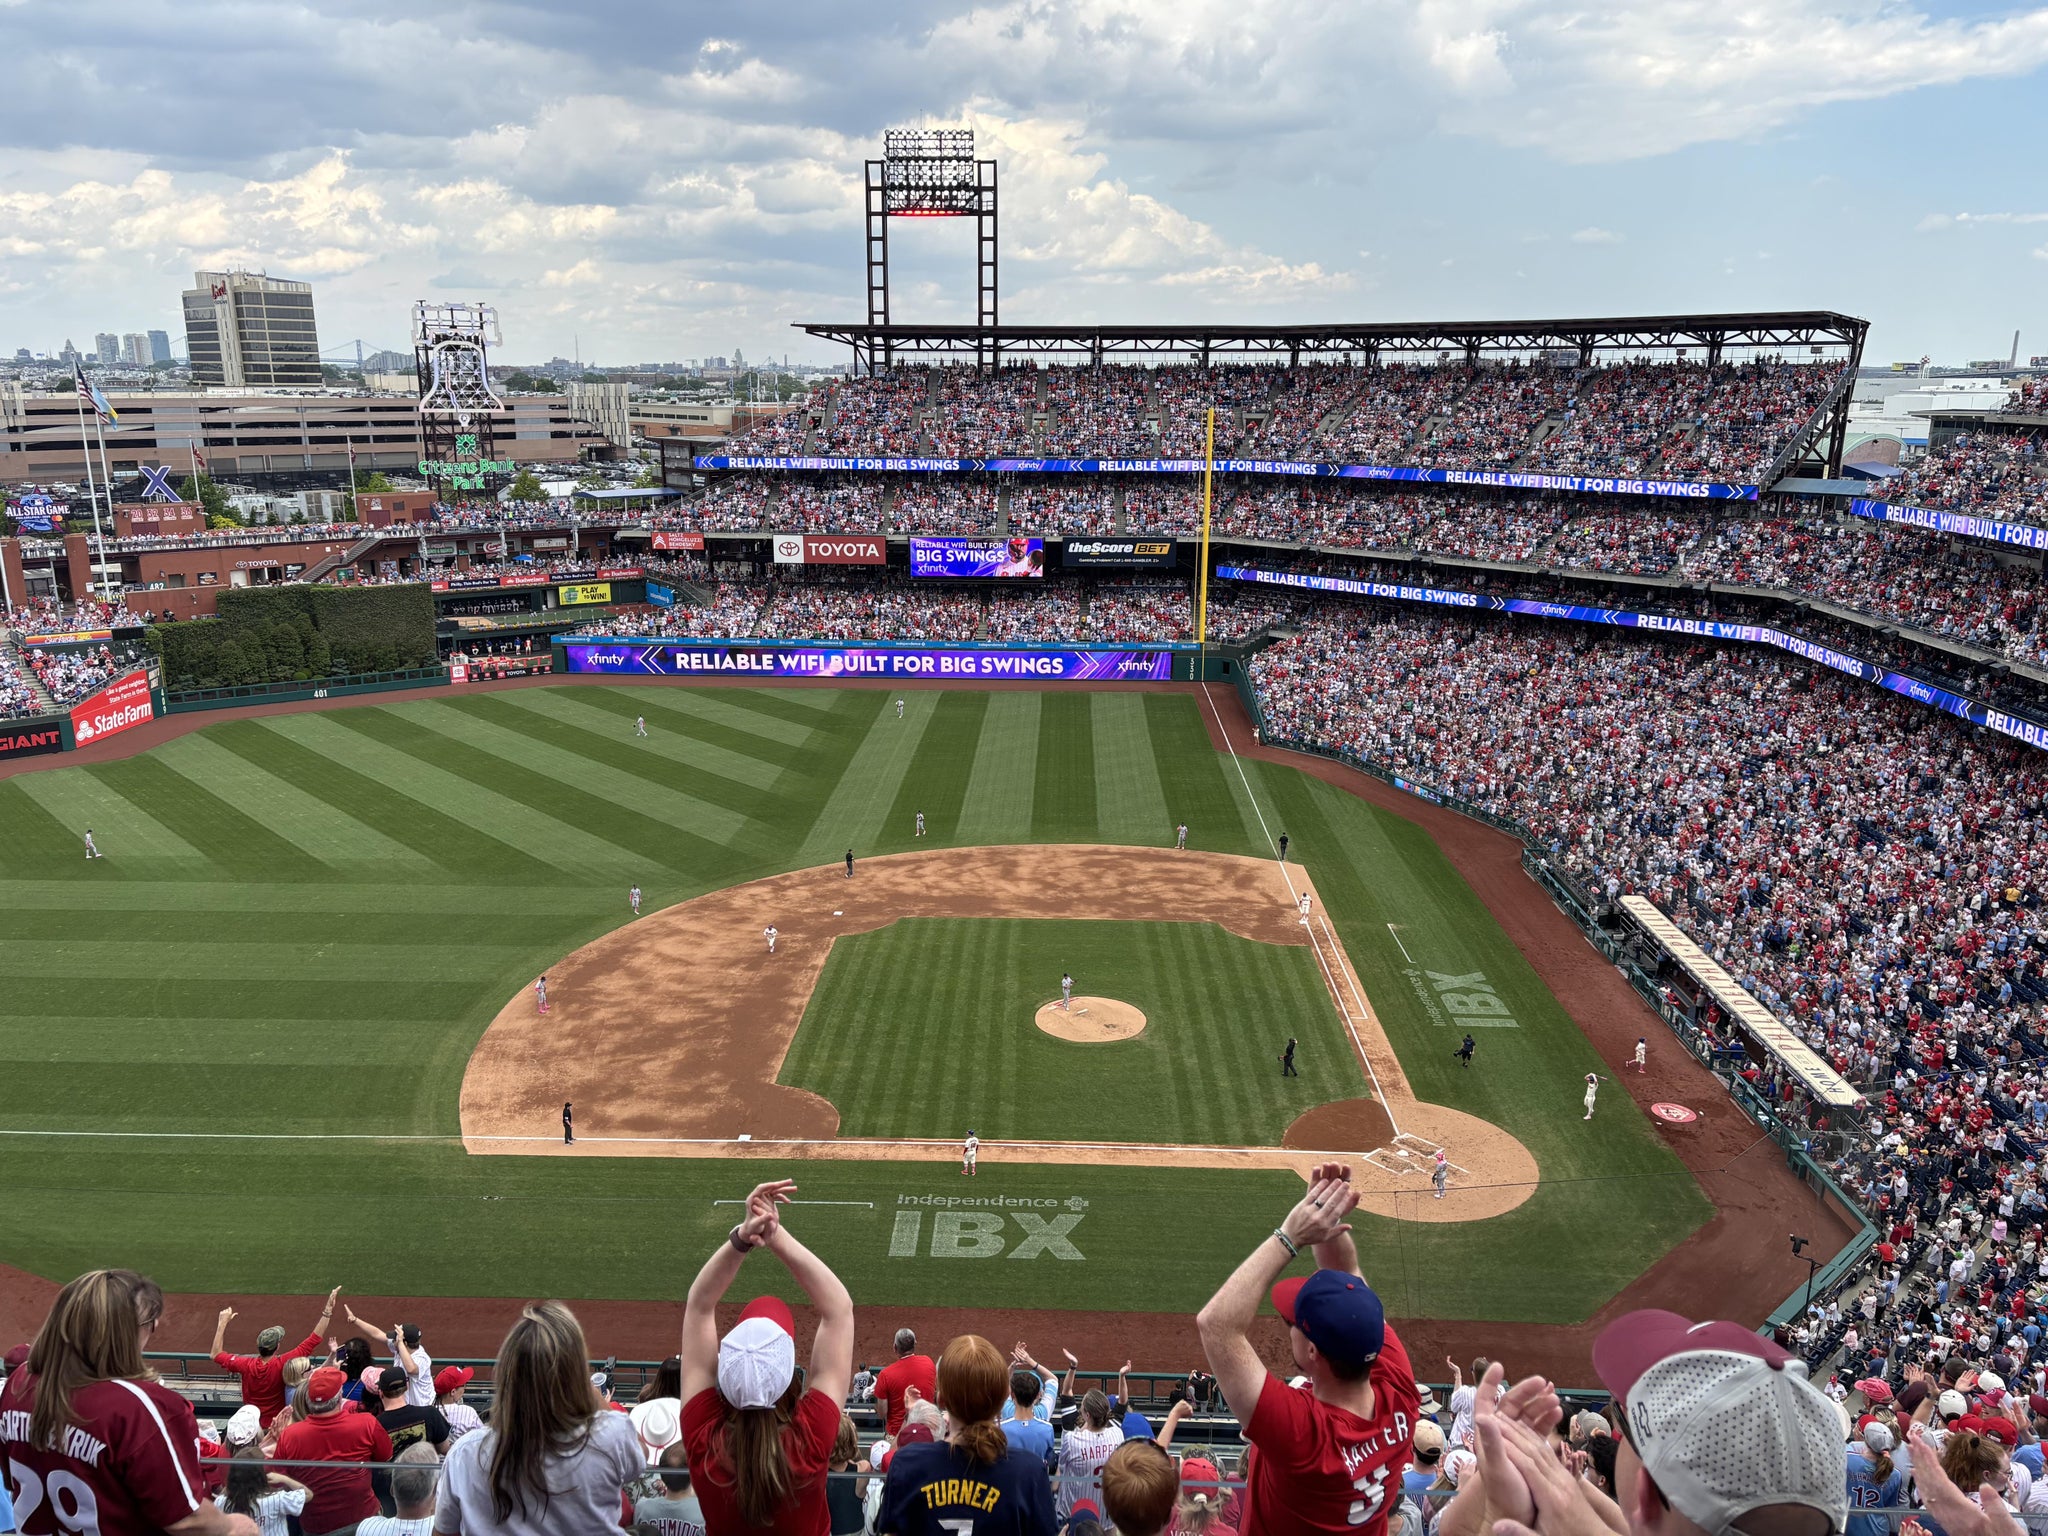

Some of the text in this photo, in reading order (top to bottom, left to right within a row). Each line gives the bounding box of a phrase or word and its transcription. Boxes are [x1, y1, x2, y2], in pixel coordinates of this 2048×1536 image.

[418, 457, 515, 474] Citizens Bank
[728, 458, 960, 470] RELIABLE WIFI BUILT FOR BIG SWINGS
[1018, 461, 1040, 470] xfinity
[1099, 460, 1316, 475] RELIABLE WIFI BUILT FOR BIG SWINGS
[1369, 468, 1390, 477] xfinity
[452, 476, 486, 490] Park
[1446, 471, 1709, 498] RELIABLE WIFI BUILT FOR BIG SWINGS
[46, 504, 70, 514] GAME
[1886, 505, 2048, 549] RELIABLE WIFI BUILT FOR BI
[808, 543, 879, 557] TOYOTA
[916, 550, 1005, 562] BIG SWINGS
[1068, 542, 1133, 553] theScore
[918, 564, 948, 573] xfinity
[1256, 571, 1477, 607] RELIABLE WIFI BUILT FOR BIG SWINGS
[1541, 605, 1567, 616] xfinity
[1637, 614, 1863, 677] RELIABLE WIFI BUILT FOR BIG SWINGS
[587, 653, 624, 666] xfinity
[676, 653, 1063, 674] RELIABLE WIFI BUILT FOR BIG SWINGS
[1118, 660, 1155, 672] xfinity
[106, 688, 115, 696] Like
[118, 684, 128, 693] good
[314, 689, 328, 698] 401
[1910, 683, 1930, 701] xfinity
[109, 695, 120, 704] State
[1986, 710, 2048, 750] RELIABLE
[1627, 901, 1806, 1051] PHILADELPHIA PHILLIES
[1410, 976, 1447, 1026] Independence
[1424, 970, 1520, 1028] IBX
[1805, 1067, 1846, 1093] HOME
[897, 1194, 1058, 1208] Independence
[888, 1210, 1087, 1260] IBX
[64, 1424, 107, 1469] KRUK
[1342, 1411, 1409, 1477] HAER
[9, 1456, 101, 1536] 29
[920, 1478, 1000, 1513] TURNER
[1852, 1485, 1880, 1509] 12
